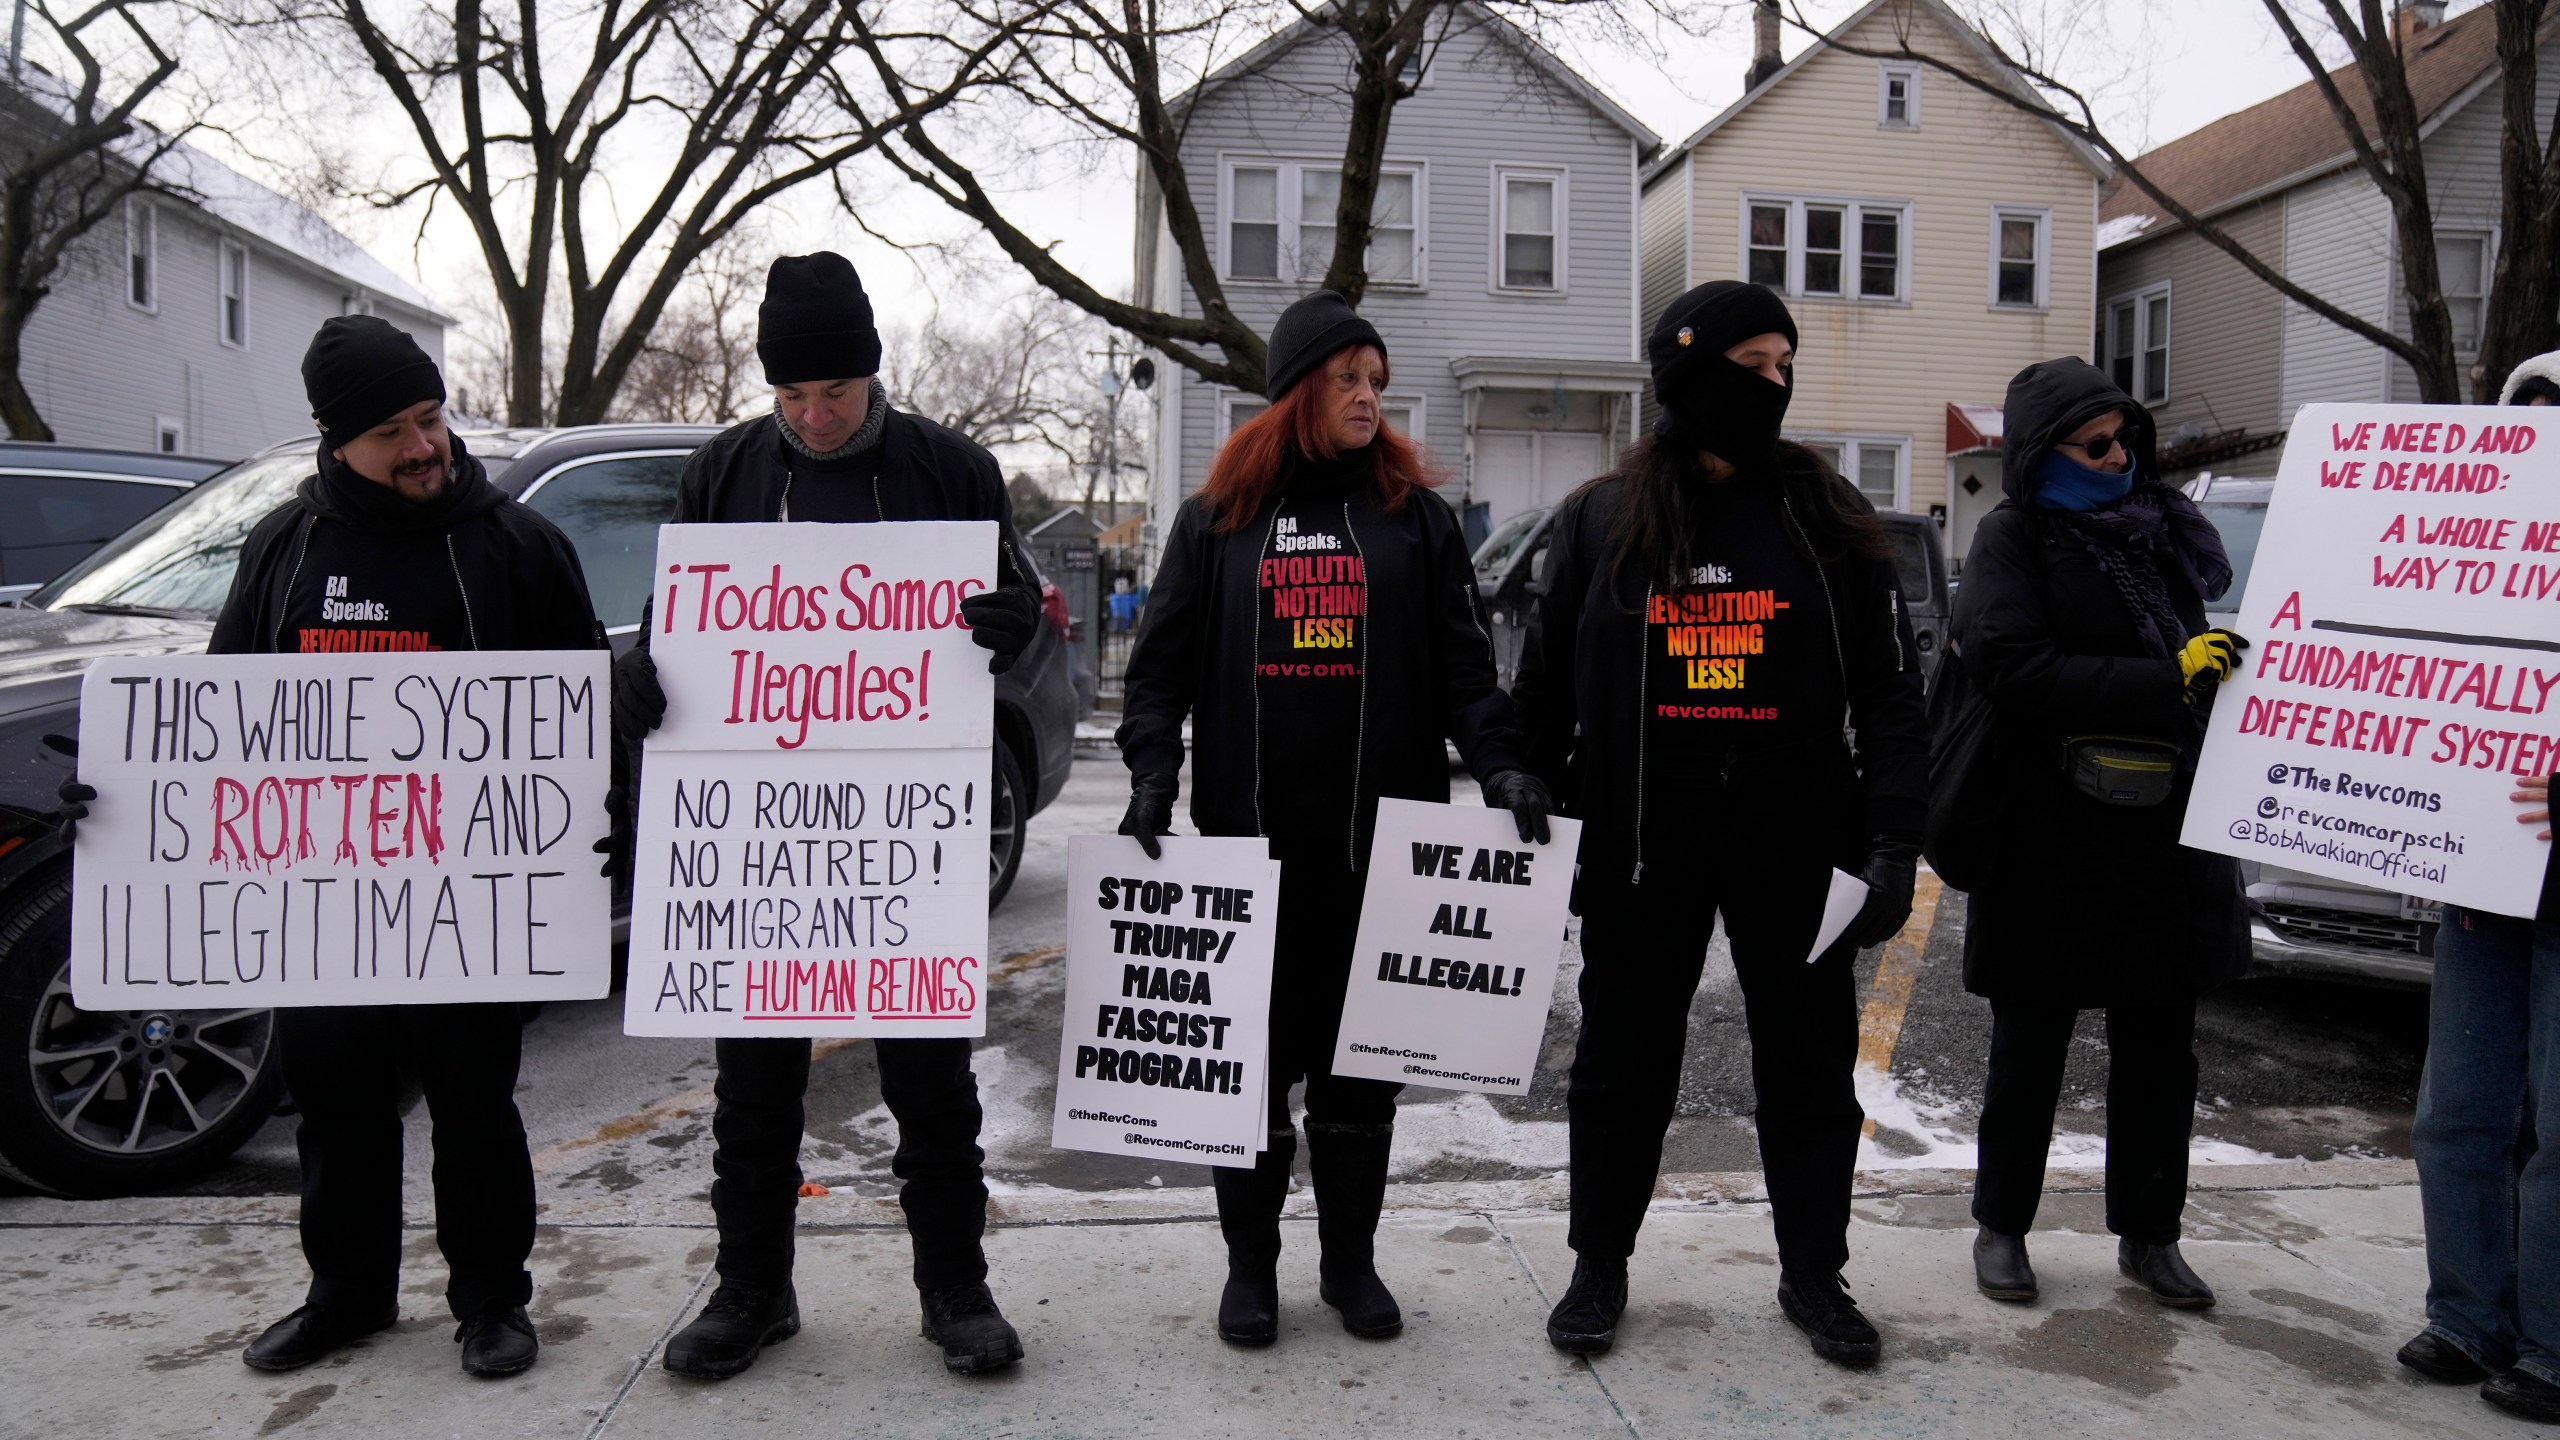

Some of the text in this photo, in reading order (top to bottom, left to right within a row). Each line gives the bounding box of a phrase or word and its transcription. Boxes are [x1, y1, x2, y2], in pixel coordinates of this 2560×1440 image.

[2332, 422, 2536, 454] WE NEED AND
[2321, 460, 2511, 494] WE DEMAND:
[1275, 533, 1342, 553] Speaks:
[1276, 517, 1297, 534] BA
[2379, 514, 2405, 543] A
[2418, 516, 2518, 551] WHOLE
[325, 575, 348, 598] BA
[836, 564, 985, 632] Somos
[2373, 555, 2560, 601] WAY TO LIV
[322, 598, 390, 622] Speaks:
[2269, 591, 2301, 631] A
[1293, 618, 1353, 649] LESS!
[1667, 624, 1763, 657] NOTHING
[1687, 658, 1745, 690] LESS!
[2256, 640, 2560, 714] FUNDAMENTALLY
[111, 675, 594, 763] THIS WHOLE SYSTEM
[724, 649, 931, 749] Ilegales!
[1658, 704, 1778, 720] revcom.us
[2238, 695, 2560, 777] DIFFERENT SYSTEM
[151, 772, 571, 875] IS ROTTEN AND
[674, 779, 973, 830] NO ROUND UPS!
[2257, 796, 2465, 855] @revcomcorpschi
[670, 840, 719, 887] NO
[1411, 842, 1534, 886] WE ARE
[2229, 819, 2447, 884] @BobAvakianOfficial
[1098, 877, 1253, 923] STOP THE
[1429, 903, 1492, 940] ALL
[102, 872, 566, 986] ILLEGITIMATE
[664, 895, 908, 951] IMMIGRANTS
[1110, 920, 1236, 963] TRUMP/
[655, 957, 977, 1014] ARE HUMAN BEINGS
[1122, 964, 1211, 1006] MAGA
[1377, 952, 1525, 997] ILLEGAL!
[1097, 1004, 1231, 1050] FASCIST
[1075, 1045, 1243, 1095] PROGRAM!
[1349, 1043, 1438, 1061] @theRevComs
[1403, 1064, 1521, 1086] @RevcomCorpsCHI
[1068, 1109, 1158, 1127] @theRevComs
[1124, 1133, 1245, 1155] @RevcomCorpsCHI
